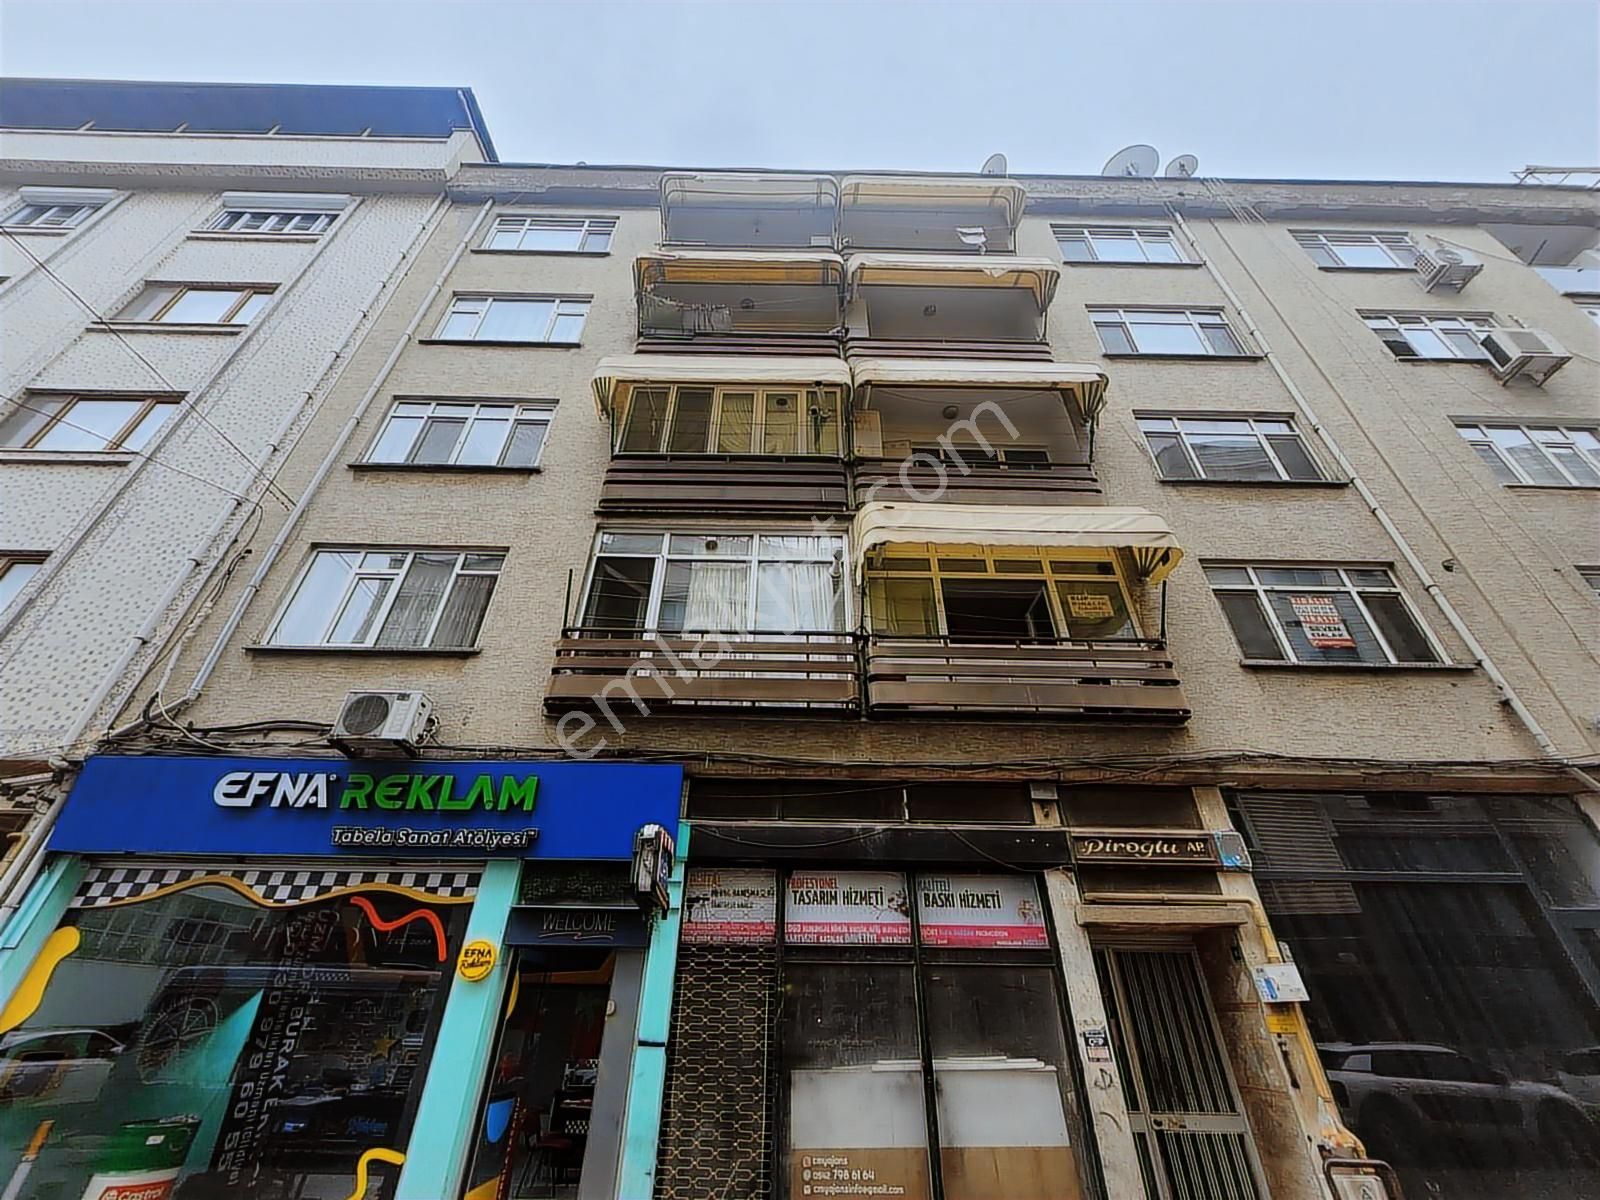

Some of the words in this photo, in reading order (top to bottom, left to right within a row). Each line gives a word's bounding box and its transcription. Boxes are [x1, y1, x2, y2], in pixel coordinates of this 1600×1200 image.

[213, 772, 329, 808] EFNA
[339, 774, 538, 811] REKLAM
[331, 828, 392, 845] Tabela
[397, 829, 449, 846] Sanat
[792, 889, 838, 905] TASARIM
[843, 886, 884, 906] HİZMETİ
[924, 892, 955, 908] BASKI
[958, 889, 1002, 909] HİZMETİ
[542, 910, 617, 932] WELCOME
[464, 948, 492, 958] EFNA
[271, 1007, 305, 1090] BURAK
[234, 1081, 254, 1118] 60
[218, 1130, 240, 1172] 55
[851, 1169, 861, 1180] 61
[862, 1169, 875, 1180] 64
